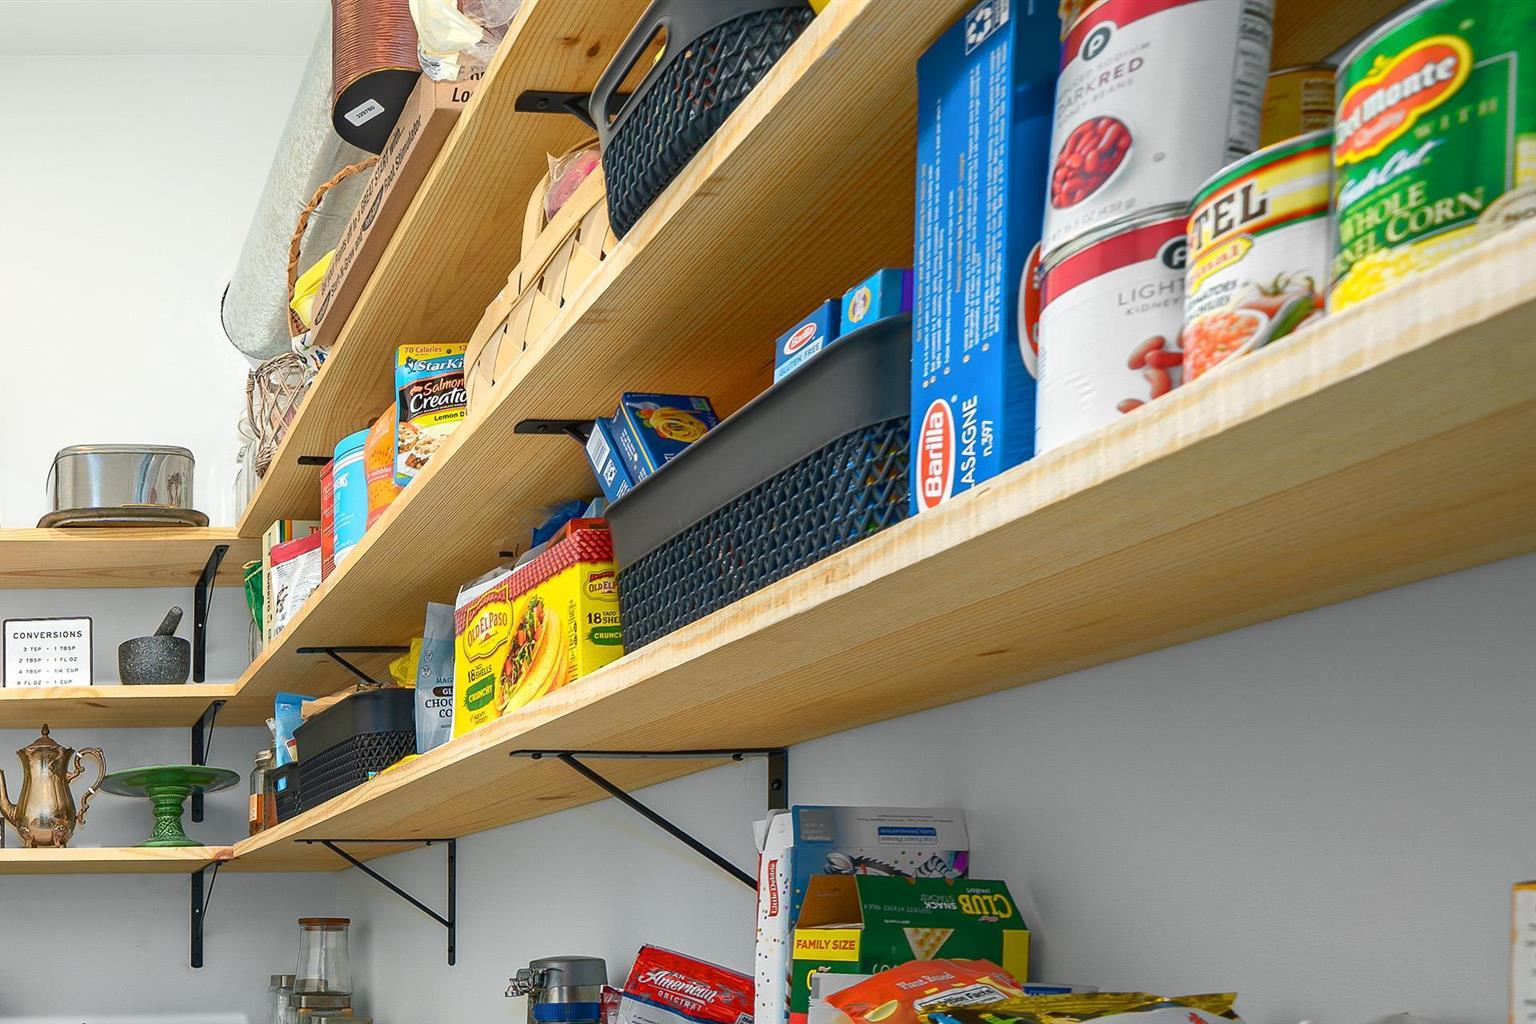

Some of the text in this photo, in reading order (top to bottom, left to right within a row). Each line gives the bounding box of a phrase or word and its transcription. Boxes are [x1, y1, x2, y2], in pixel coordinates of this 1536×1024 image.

[1098, 57, 1144, 87] RED
[1365, 56, 1457, 122] Monte
[1189, 183, 1267, 250] TEL
[1386, 186, 1486, 242] CORN
[417, 358, 465, 371] StarKi
[423, 378, 464, 396] Salmon
[434, 412, 458, 422] Lemon
[961, 395, 978, 487] ASAGNE
[925, 411, 943, 498] Barilla
[588, 583, 603, 593] OLD
[586, 613, 620, 625] 18 SHE
[13, 630, 83, 640] CONVERSIONS
[468, 624, 480, 644] OLD
[467, 668, 475, 683] 18
[768, 863, 779, 914] Little Debbie
[925, 901, 958, 910] SNACK
[957, 894, 1013, 919] CLUB
[796, 939, 856, 951] FAMILY SIZE
[638, 969, 718, 1004] American
[896, 975, 925, 990] Plant
